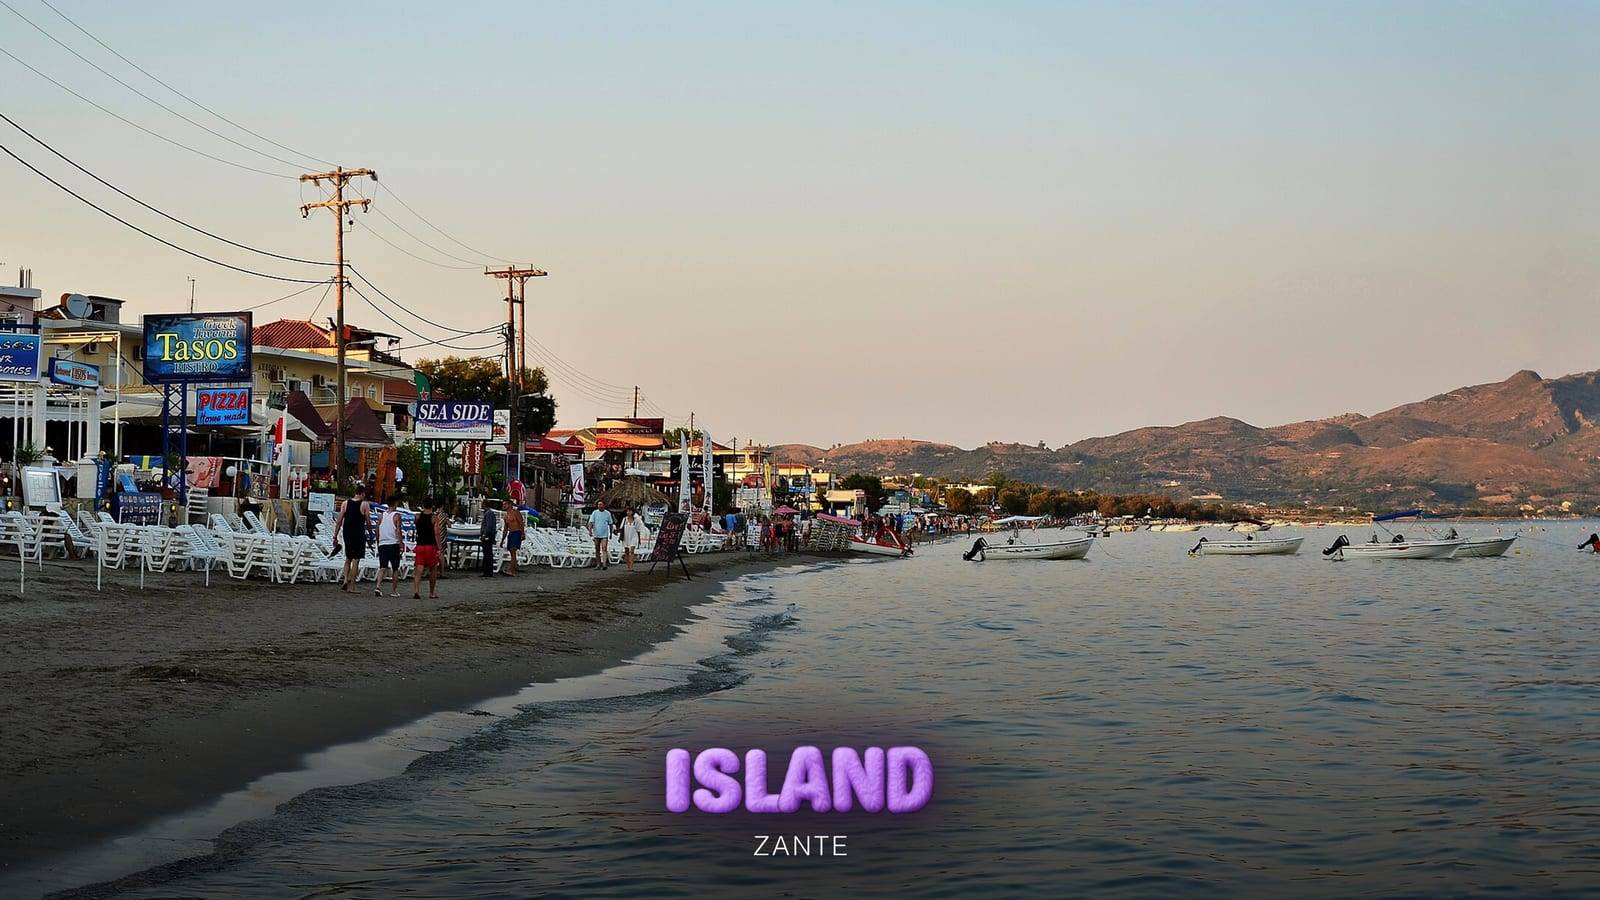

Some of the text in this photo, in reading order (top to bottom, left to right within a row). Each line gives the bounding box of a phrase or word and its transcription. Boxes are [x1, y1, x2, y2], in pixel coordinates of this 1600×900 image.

[202, 319, 237, 330] Greek
[193, 328, 237, 339] Taverna
[155, 332, 238, 361] Tasos
[173, 361, 218, 373] BISTRO
[199, 392, 247, 410] PIZZA
[200, 410, 246, 423] Home made
[418, 403, 448, 420] SEA
[452, 404, 490, 421] SIDE
